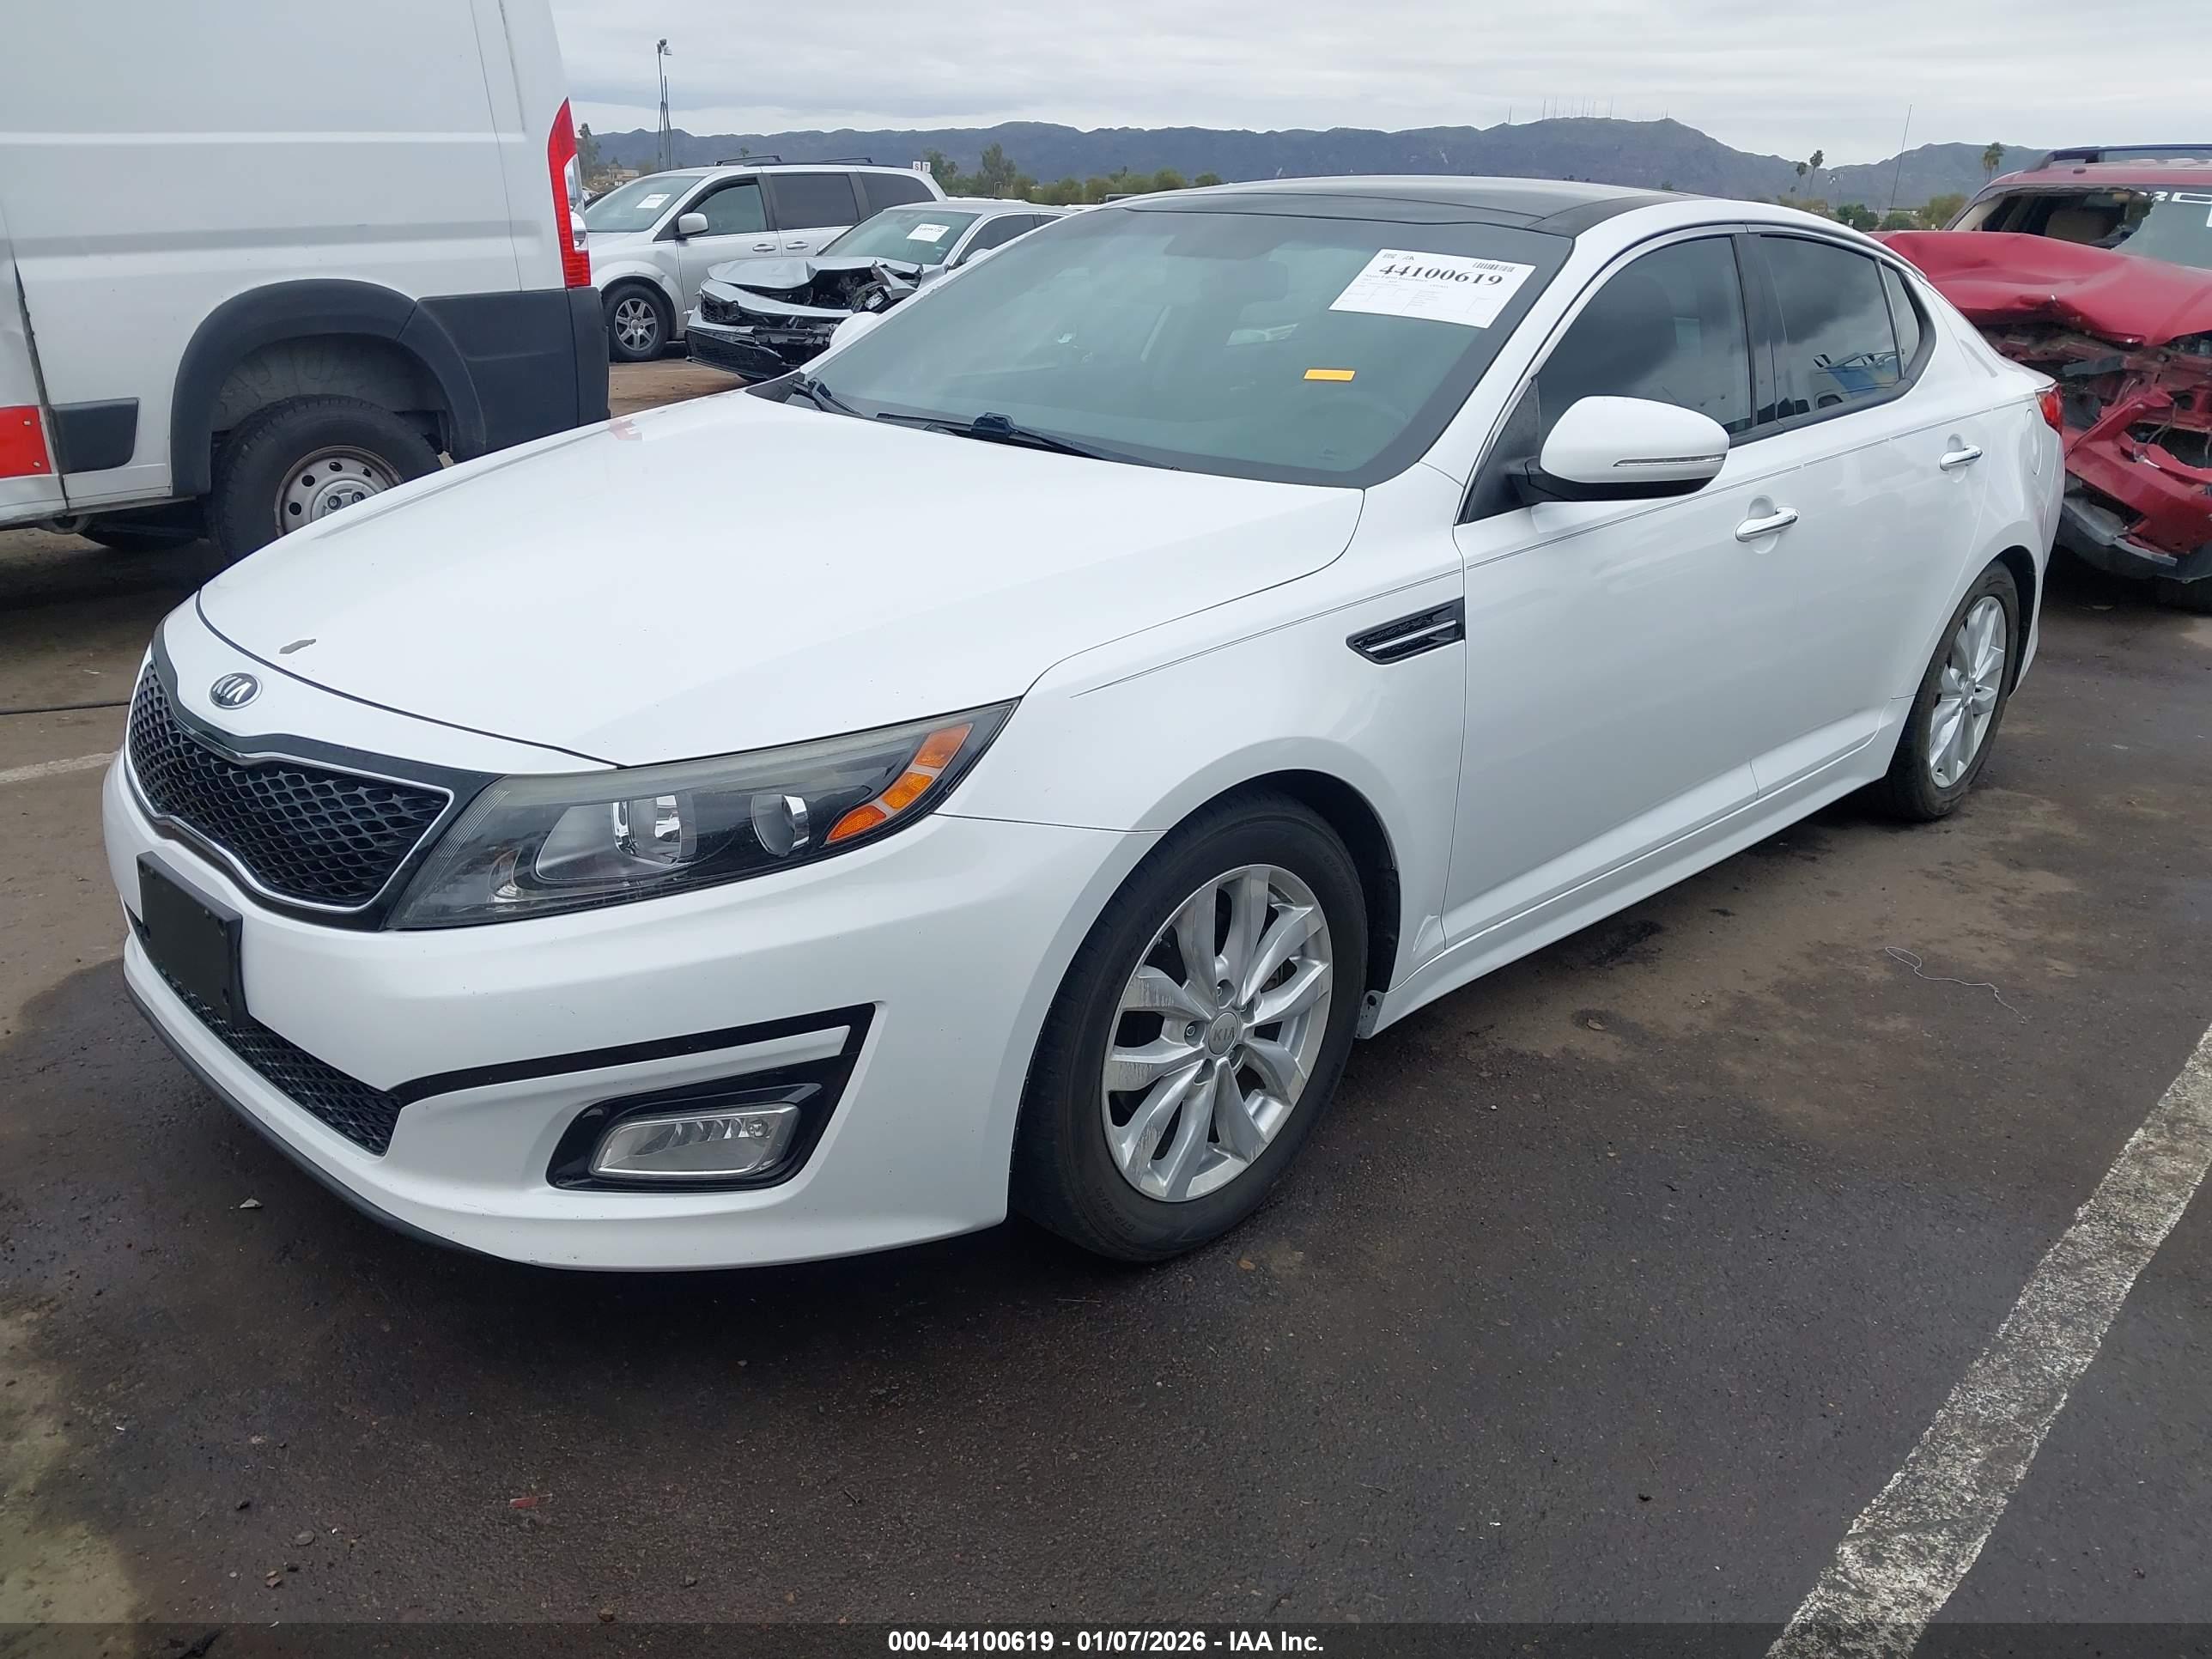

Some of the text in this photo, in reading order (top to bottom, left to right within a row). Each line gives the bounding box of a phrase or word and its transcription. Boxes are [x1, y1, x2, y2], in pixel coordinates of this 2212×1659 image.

[1378, 264, 1504, 286] 44100619
[212, 674, 252, 703] KIA
[1212, 1026, 1235, 1042] KIA
